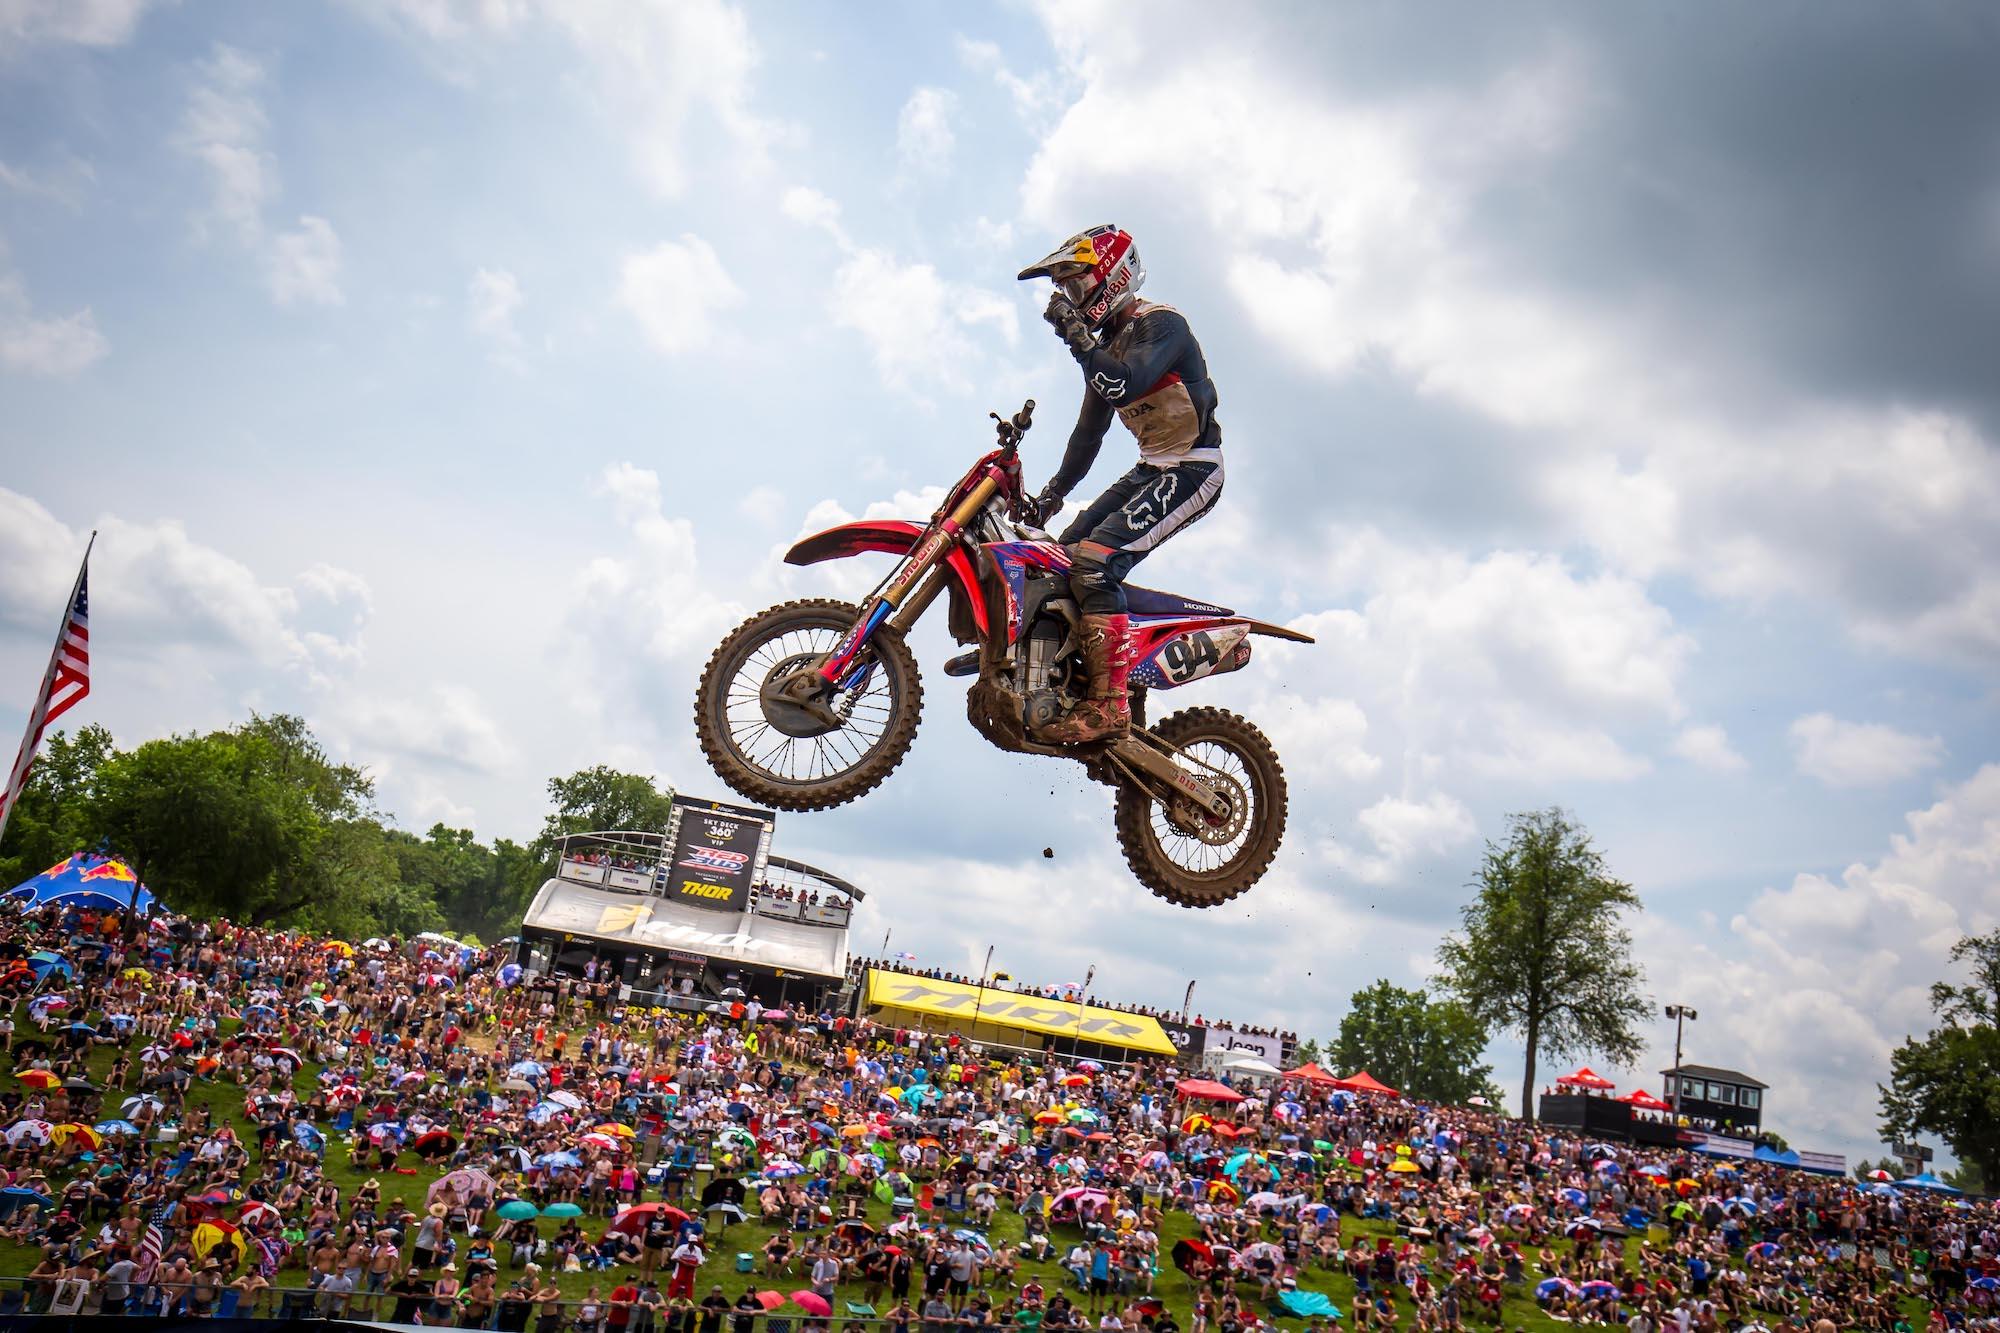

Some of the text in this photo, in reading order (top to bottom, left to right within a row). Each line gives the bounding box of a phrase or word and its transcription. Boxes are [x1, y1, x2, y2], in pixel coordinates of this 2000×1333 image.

[1099, 252, 1116, 274] FOX
[1183, 602, 1222, 613] HONDA
[1164, 630, 1220, 682] 94
[703, 818, 740, 830] SKY DECK
[681, 880, 733, 901] THOR
[888, 984, 1144, 1039] THOR
[1163, 1029, 1191, 1048] ep
